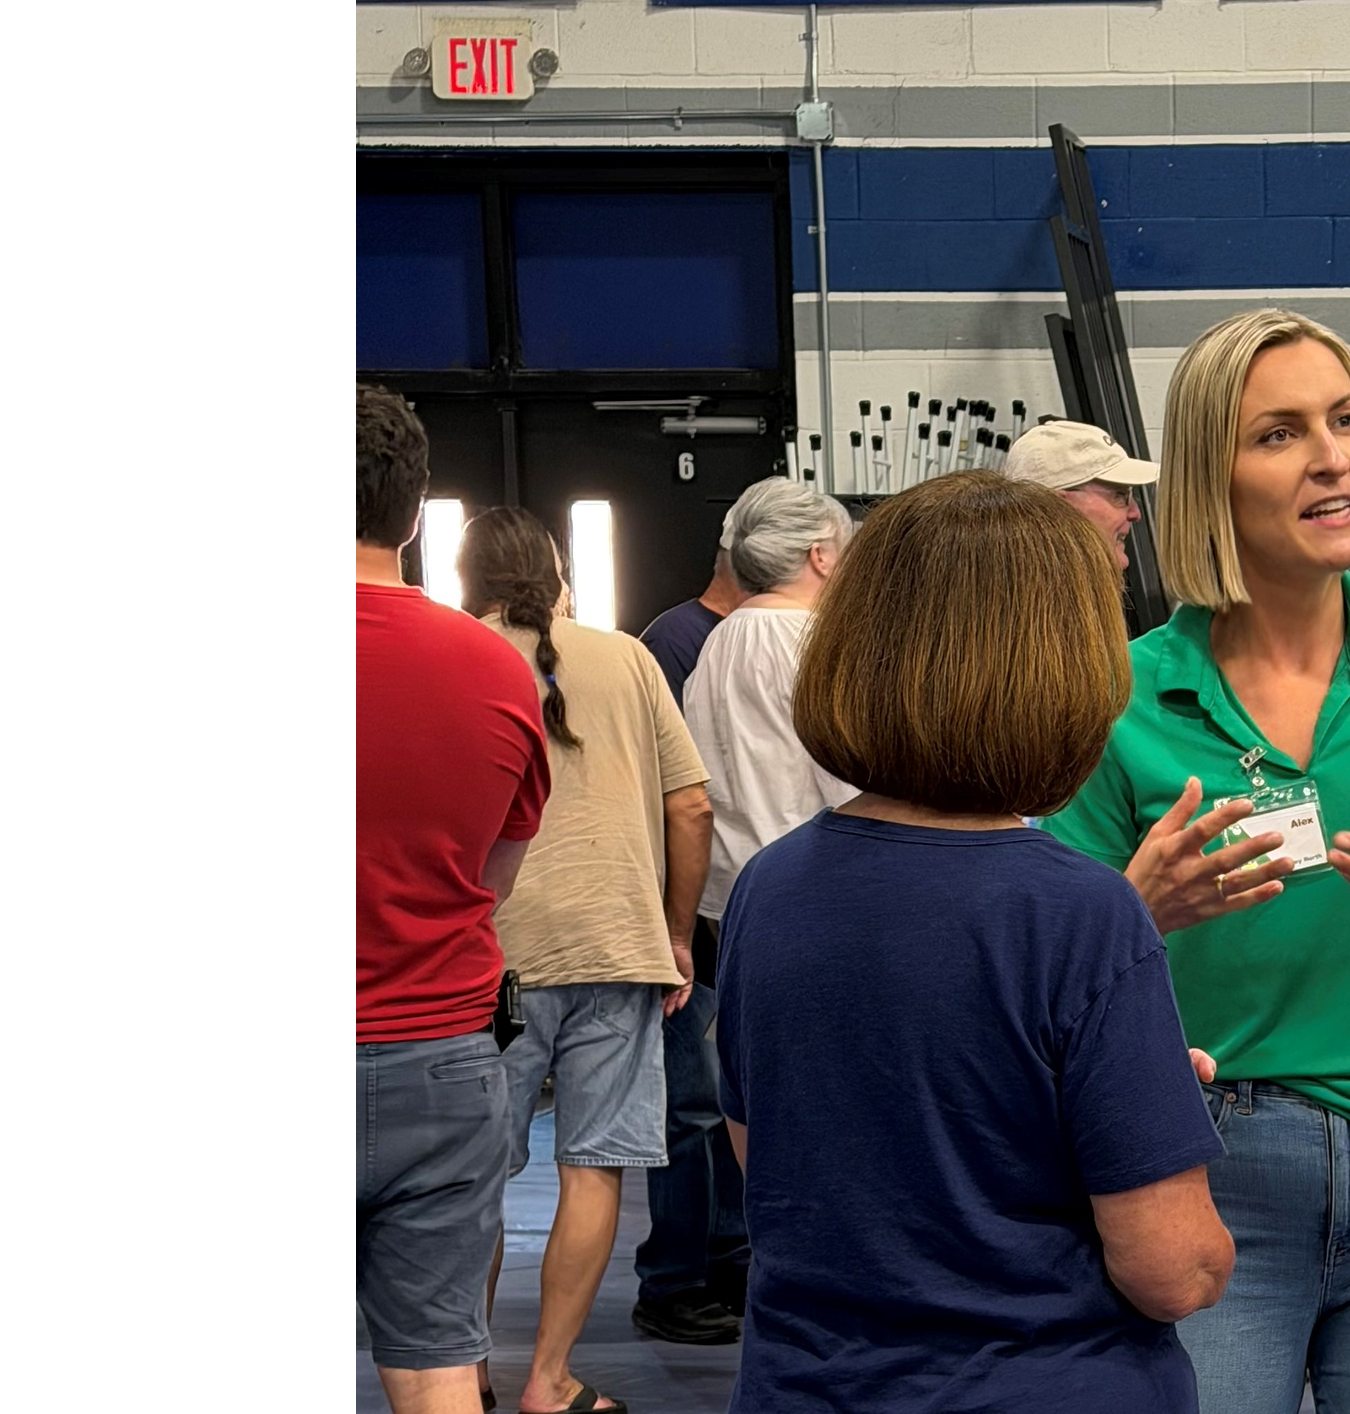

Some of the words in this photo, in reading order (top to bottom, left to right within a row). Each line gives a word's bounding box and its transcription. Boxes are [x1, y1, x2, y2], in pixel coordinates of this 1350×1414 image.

[449, 38, 518, 94] EXIT
[678, 452, 694, 480] 6
[1291, 817, 1314, 829] Alex
